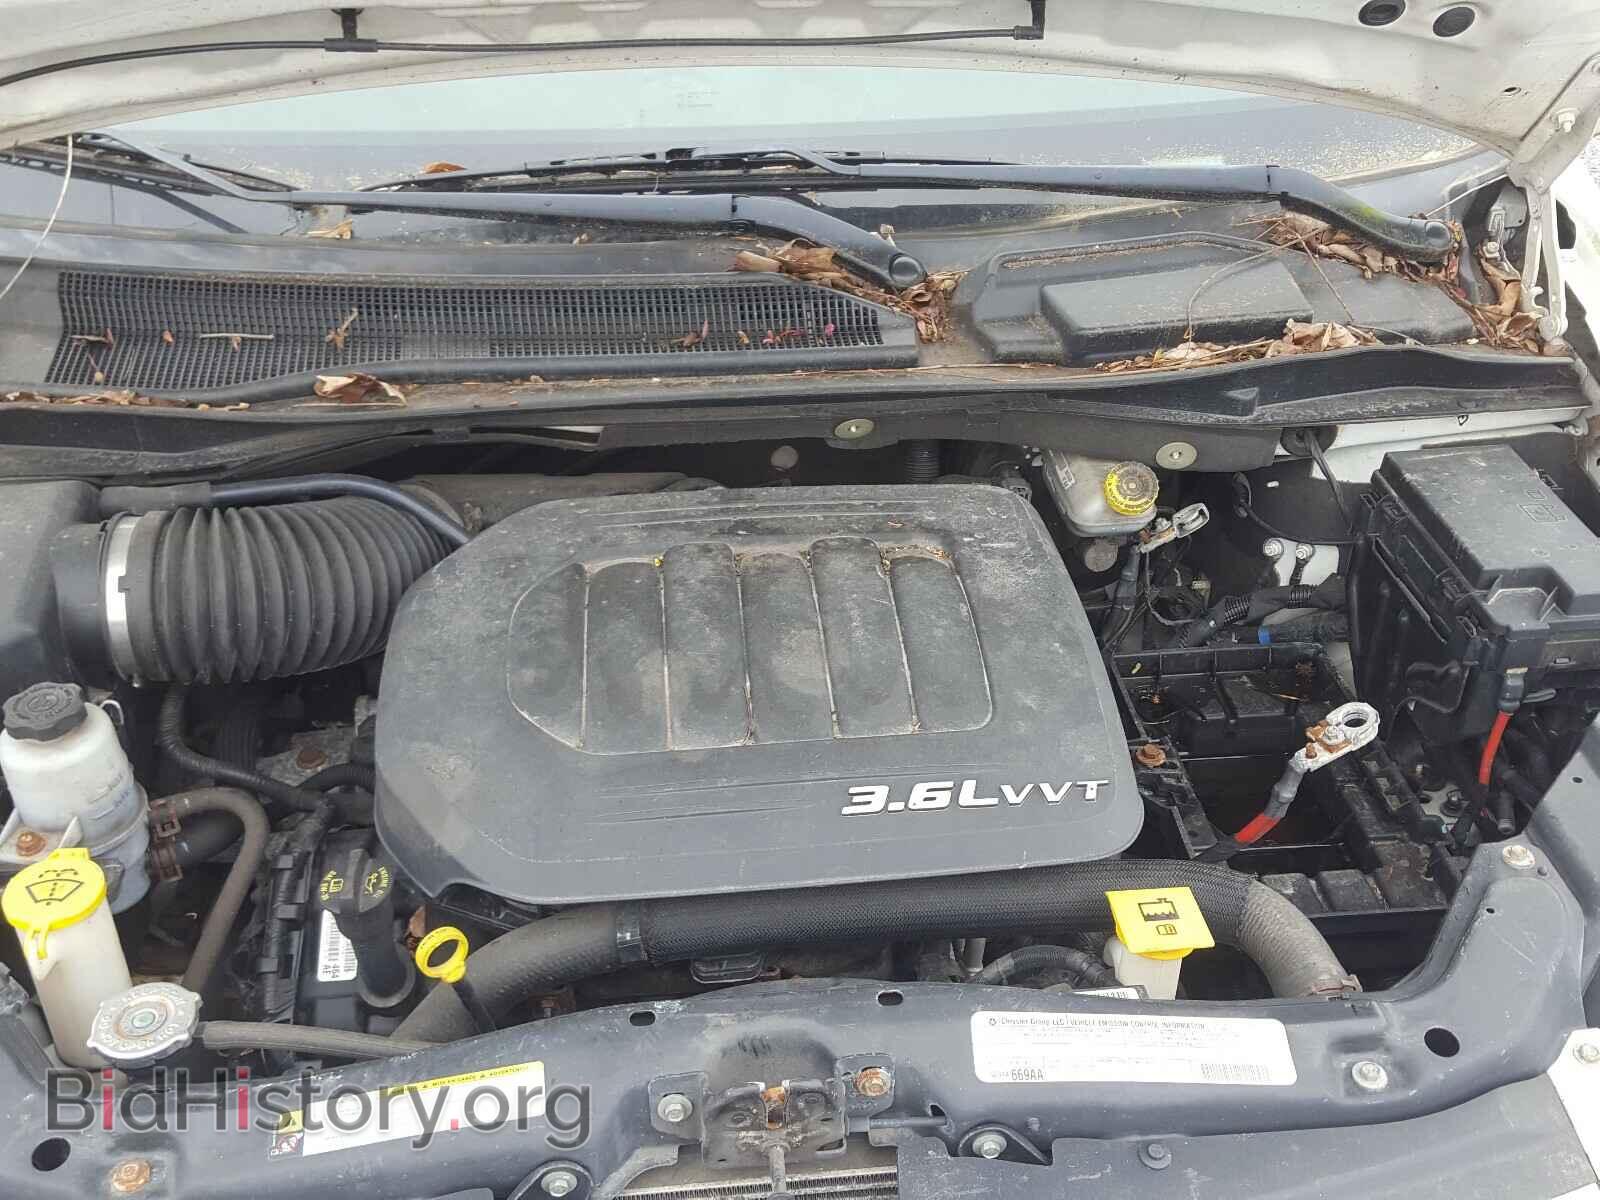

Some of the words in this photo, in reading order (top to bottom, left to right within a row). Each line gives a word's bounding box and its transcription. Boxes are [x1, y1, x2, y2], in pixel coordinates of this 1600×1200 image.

[842, 779, 999, 816] 3.6L
[1000, 780, 1109, 807] VVT
[1011, 1068, 1044, 1081] 669AA
